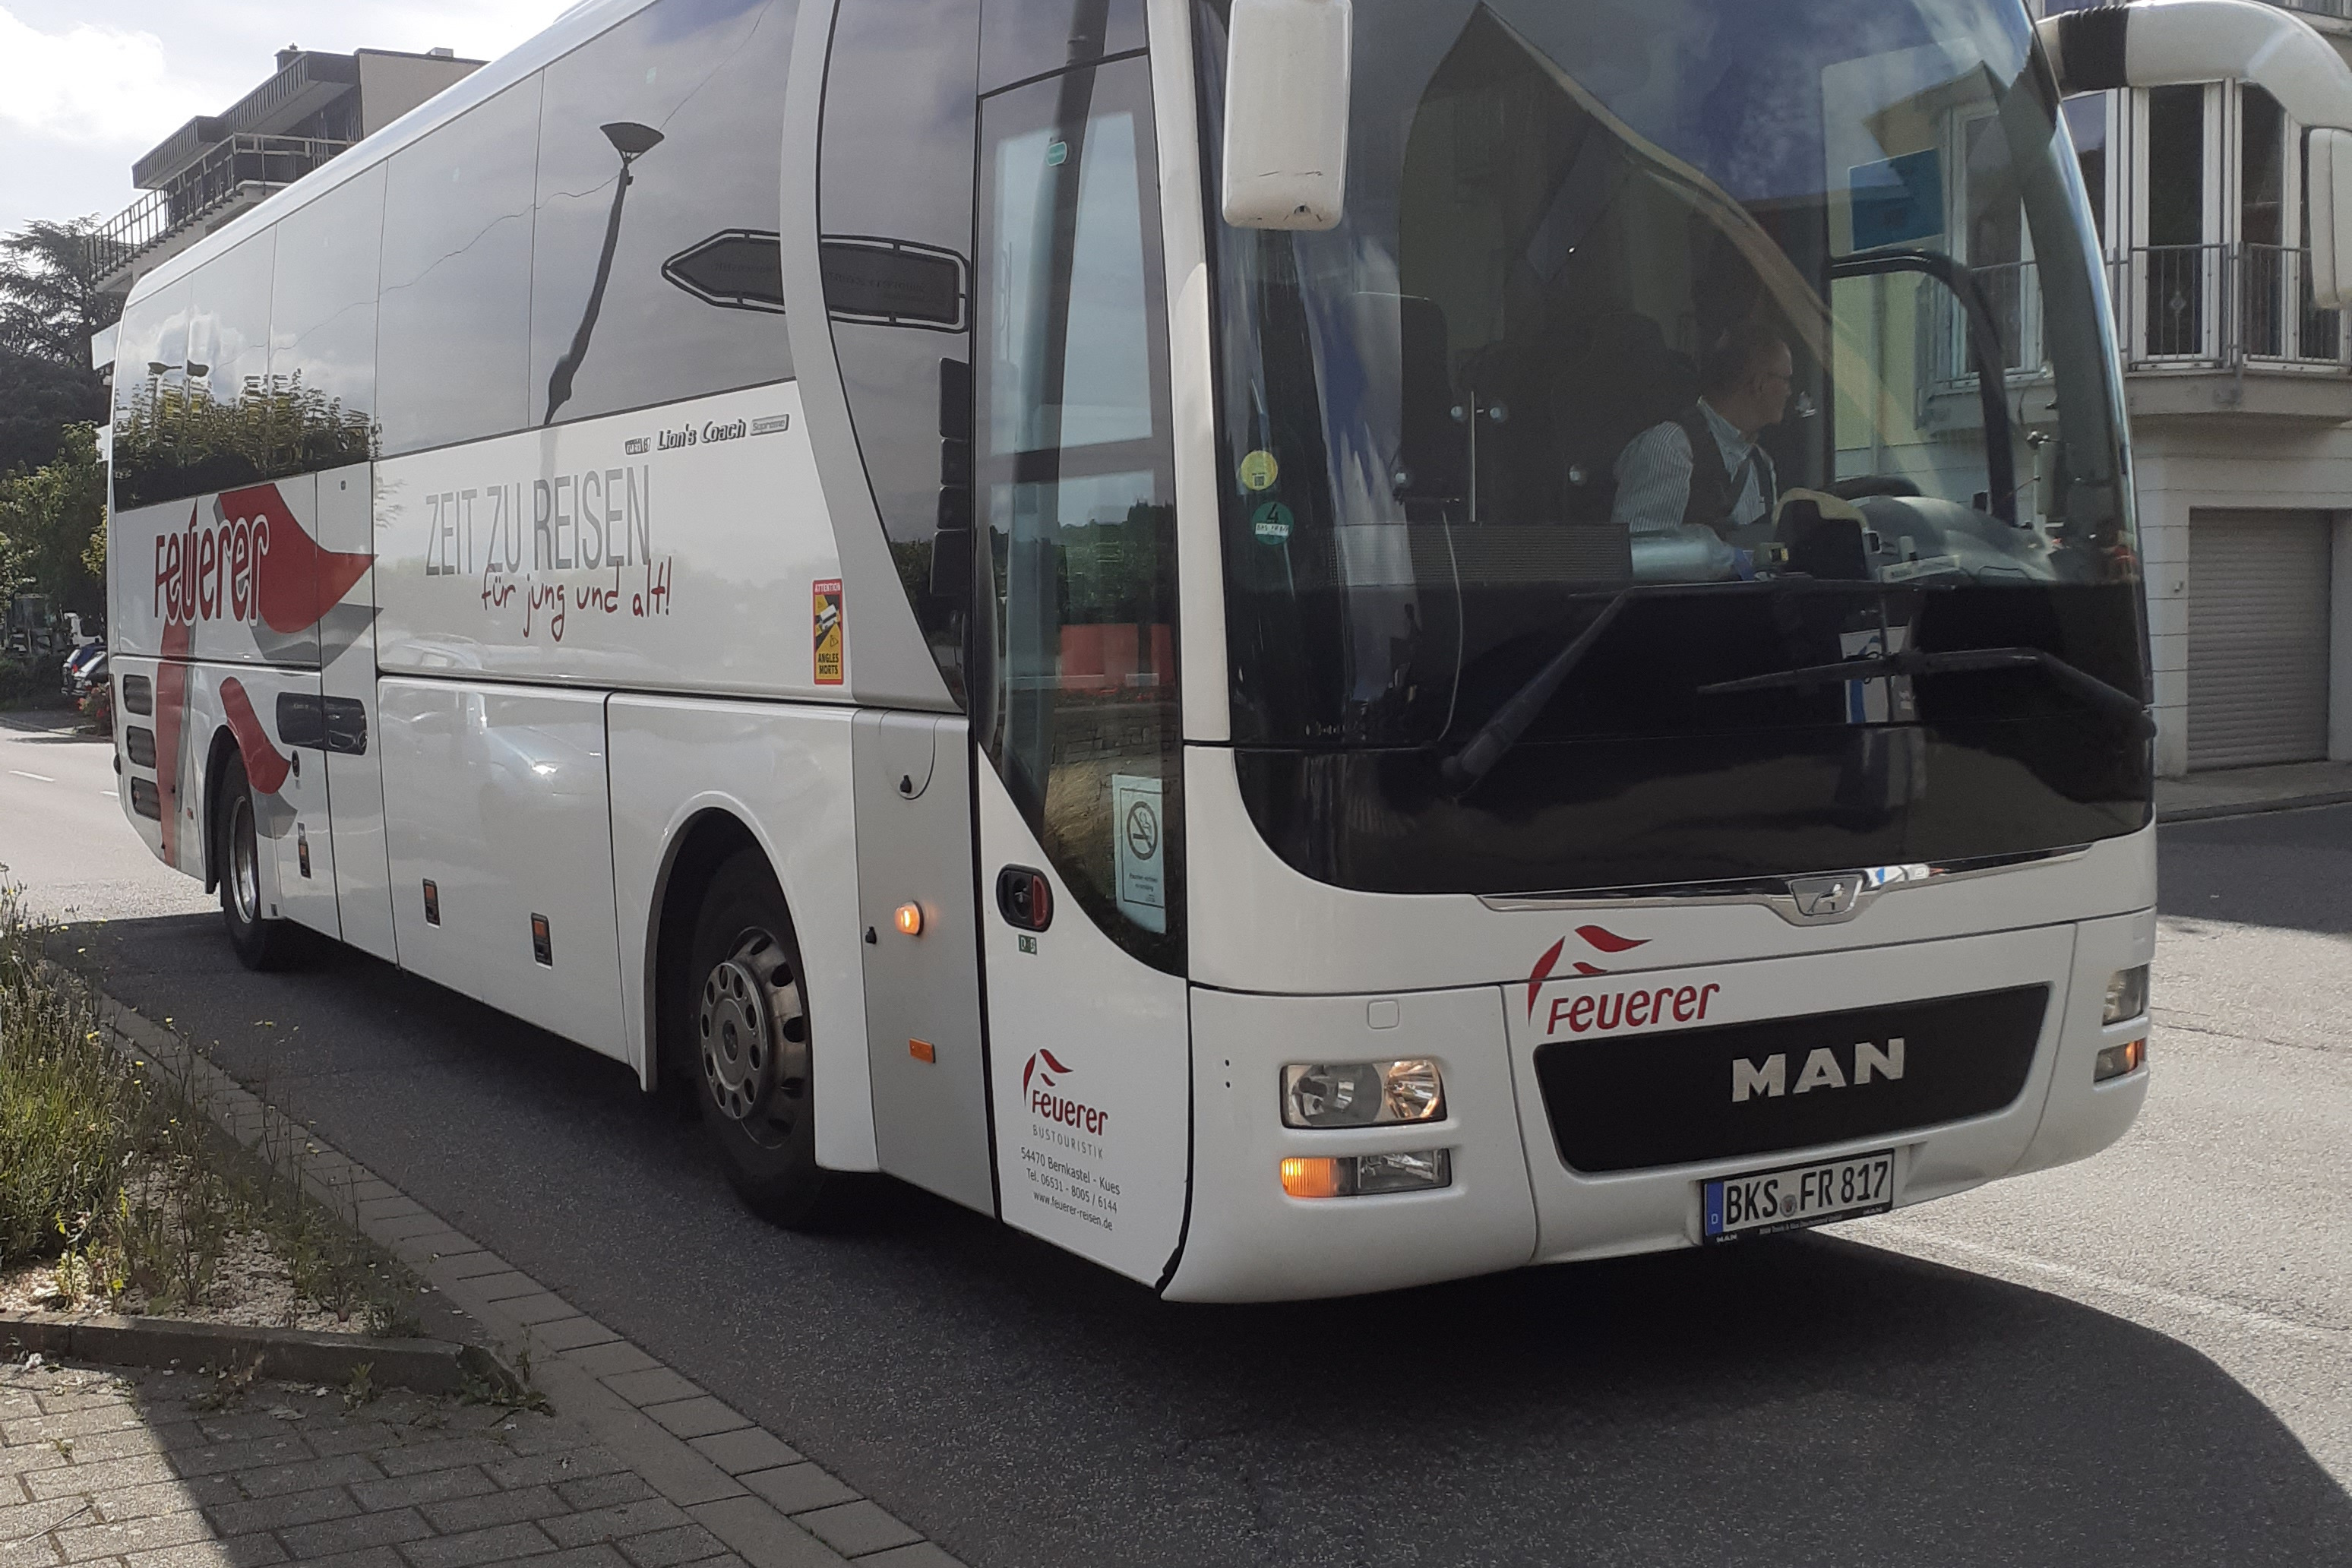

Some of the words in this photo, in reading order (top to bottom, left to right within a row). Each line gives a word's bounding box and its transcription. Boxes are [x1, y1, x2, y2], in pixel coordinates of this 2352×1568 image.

[657, 423, 697, 450] Lion's
[700, 419, 746, 444] Coach
[426, 488, 477, 576] ZEIT
[486, 482, 521, 574] ZU
[533, 464, 649, 571] REISEN
[482, 564, 516, 610] für
[523, 573, 564, 642] jung
[577, 560, 620, 613] und
[632, 555, 672, 618] alt!
[818, 653, 839, 663] ANGLES
[819, 664, 839, 675] MORTS
[1547, 983, 1720, 1035] Feuerer
[1732, 1038, 1904, 1102] MAN
[1032, 1089, 1108, 1136] Feuerer
[1032, 1124, 1104, 1159] BUSTOURISTIK
[1021, 1147, 1045, 1167] 54470
[1048, 1156, 1090, 1184] Bernkastel
[1099, 1177, 1121, 1196] Kues
[1026, 1168, 1039, 1183] Tel.
[1041, 1174, 1063, 1193] 06531
[1071, 1185, 1090, 1203] 8005
[1098, 1196, 1118, 1214] 6144
[1726, 1180, 1778, 1225] BKS
[1800, 1169, 1833, 1211] FR
[1841, 1161, 1888, 1203] 817
[1033, 1190, 1113, 1231] www.feuerer-reisen.de
[1716, 1233, 1737, 1243] MAN
